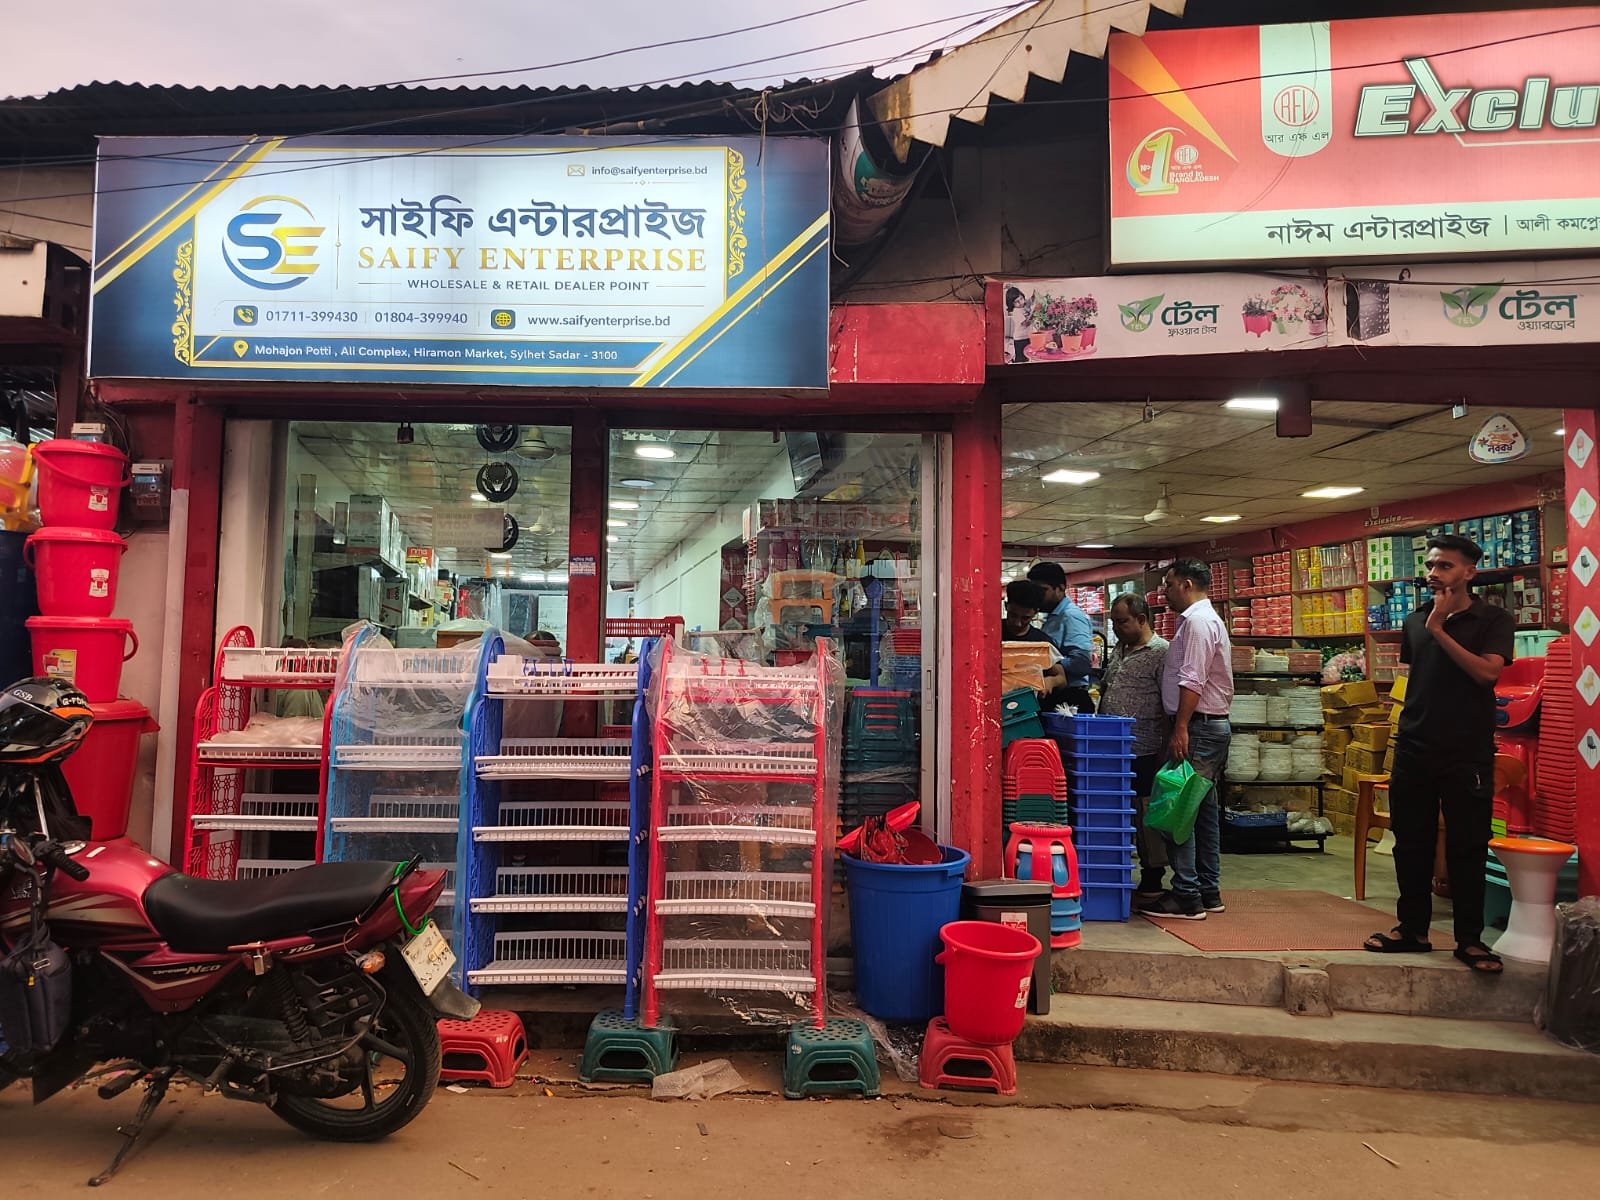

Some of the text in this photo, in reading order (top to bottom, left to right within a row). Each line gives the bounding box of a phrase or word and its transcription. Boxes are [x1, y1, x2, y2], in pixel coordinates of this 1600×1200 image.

[1279, 87, 1316, 124] RFL
[1265, 131, 1329, 143] আর এফ এল
[591, 164, 708, 177] info@saifyenterprise.bd
[1169, 175, 1220, 184] BANGLADESH
[359, 194, 707, 241] সাইফি এন্টারপ্রাইজ
[1517, 213, 1600, 232] আলী কমপ্লে
[1266, 212, 1492, 245] নাঈম এন্টারপ্রাইজ
[357, 246, 707, 272] SAIFY ENTERPRISE
[407, 279, 649, 291] WHOLESALE & RETAIL DEALER POINT
[1499, 290, 1578, 320] টেল
[265, 310, 358, 323] 01711-399430
[374, 311, 468, 324] 01804-399940
[527, 314, 671, 328] www.saifyenterprise.bd
[1161, 301, 1220, 326] টেল
[255, 345, 303, 357] Mohajon
[306, 345, 332, 356] Potti
[340, 346, 356, 356] Ali
[358, 346, 411, 359] Complex,
[413, 348, 461, 358] Hiramon
[464, 348, 508, 360] Market,
[510, 349, 545, 361] Sylhet
[548, 349, 581, 360] Sadar
[591, 350, 618, 361] 3100
[13, 689, 33, 701] GSB
